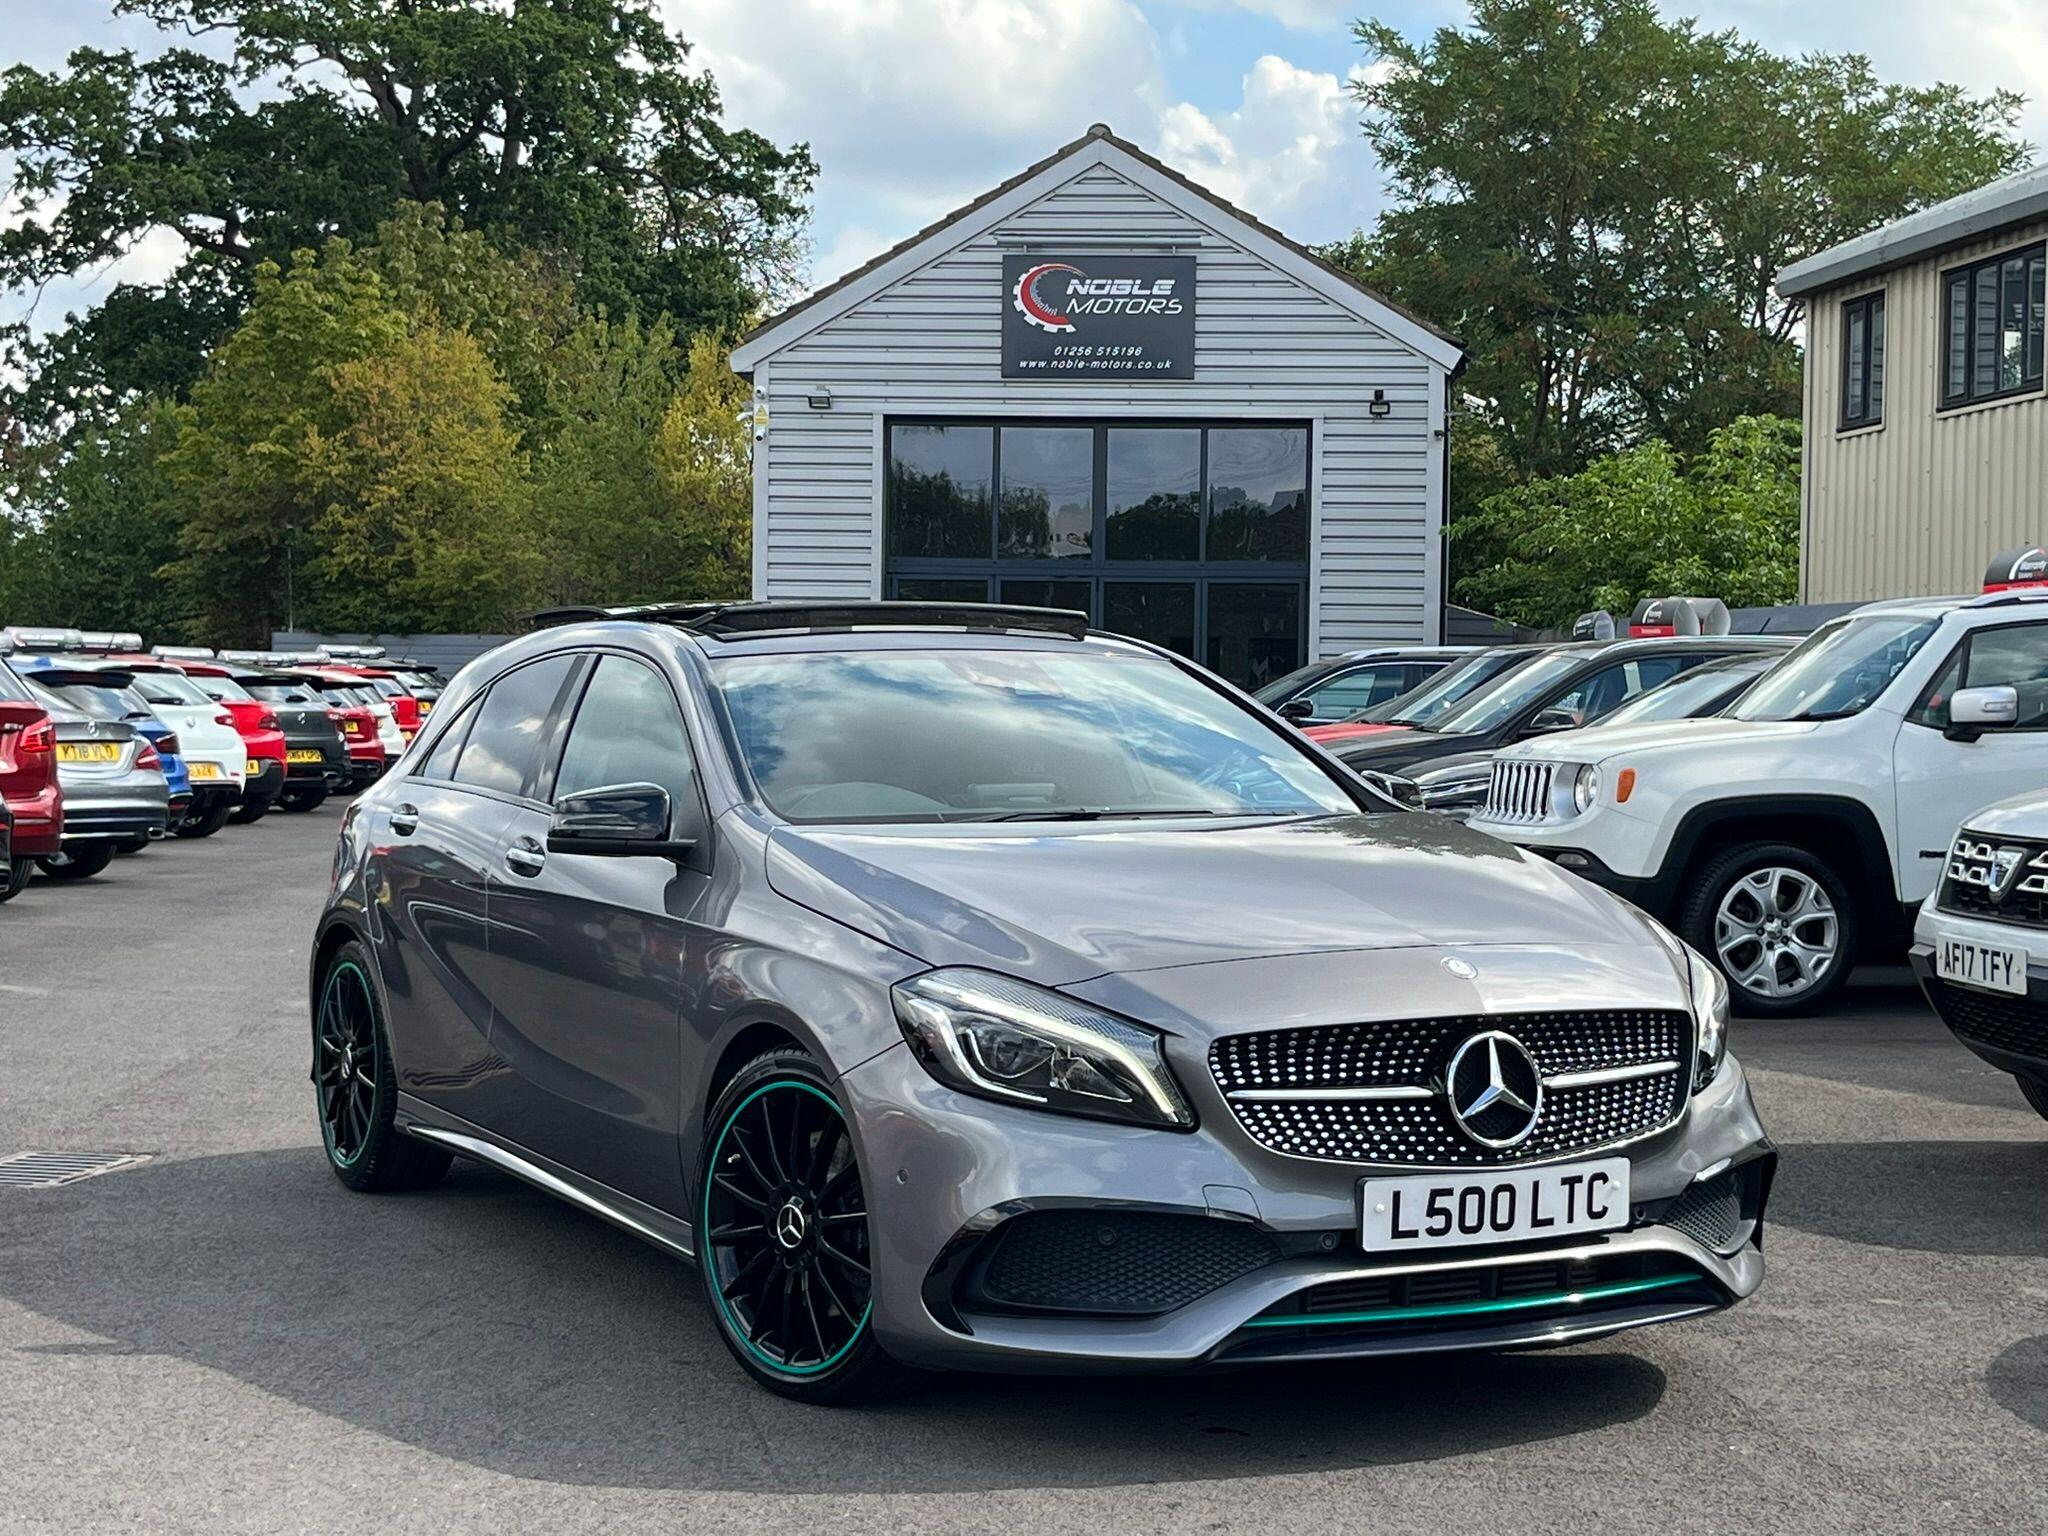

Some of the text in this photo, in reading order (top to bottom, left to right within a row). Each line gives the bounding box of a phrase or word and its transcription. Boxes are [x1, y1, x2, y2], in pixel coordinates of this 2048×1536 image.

[1066, 279, 1176, 295] NOBLE
[1065, 298, 1183, 314] MOTORS
[1054, 346, 1092, 356] 01256
[1019, 359, 1172, 369] www.noble-motors.co.uk
[1944, 941, 2013, 985] AF17 TFY
[1391, 1171, 1609, 1240] L500 LTC
